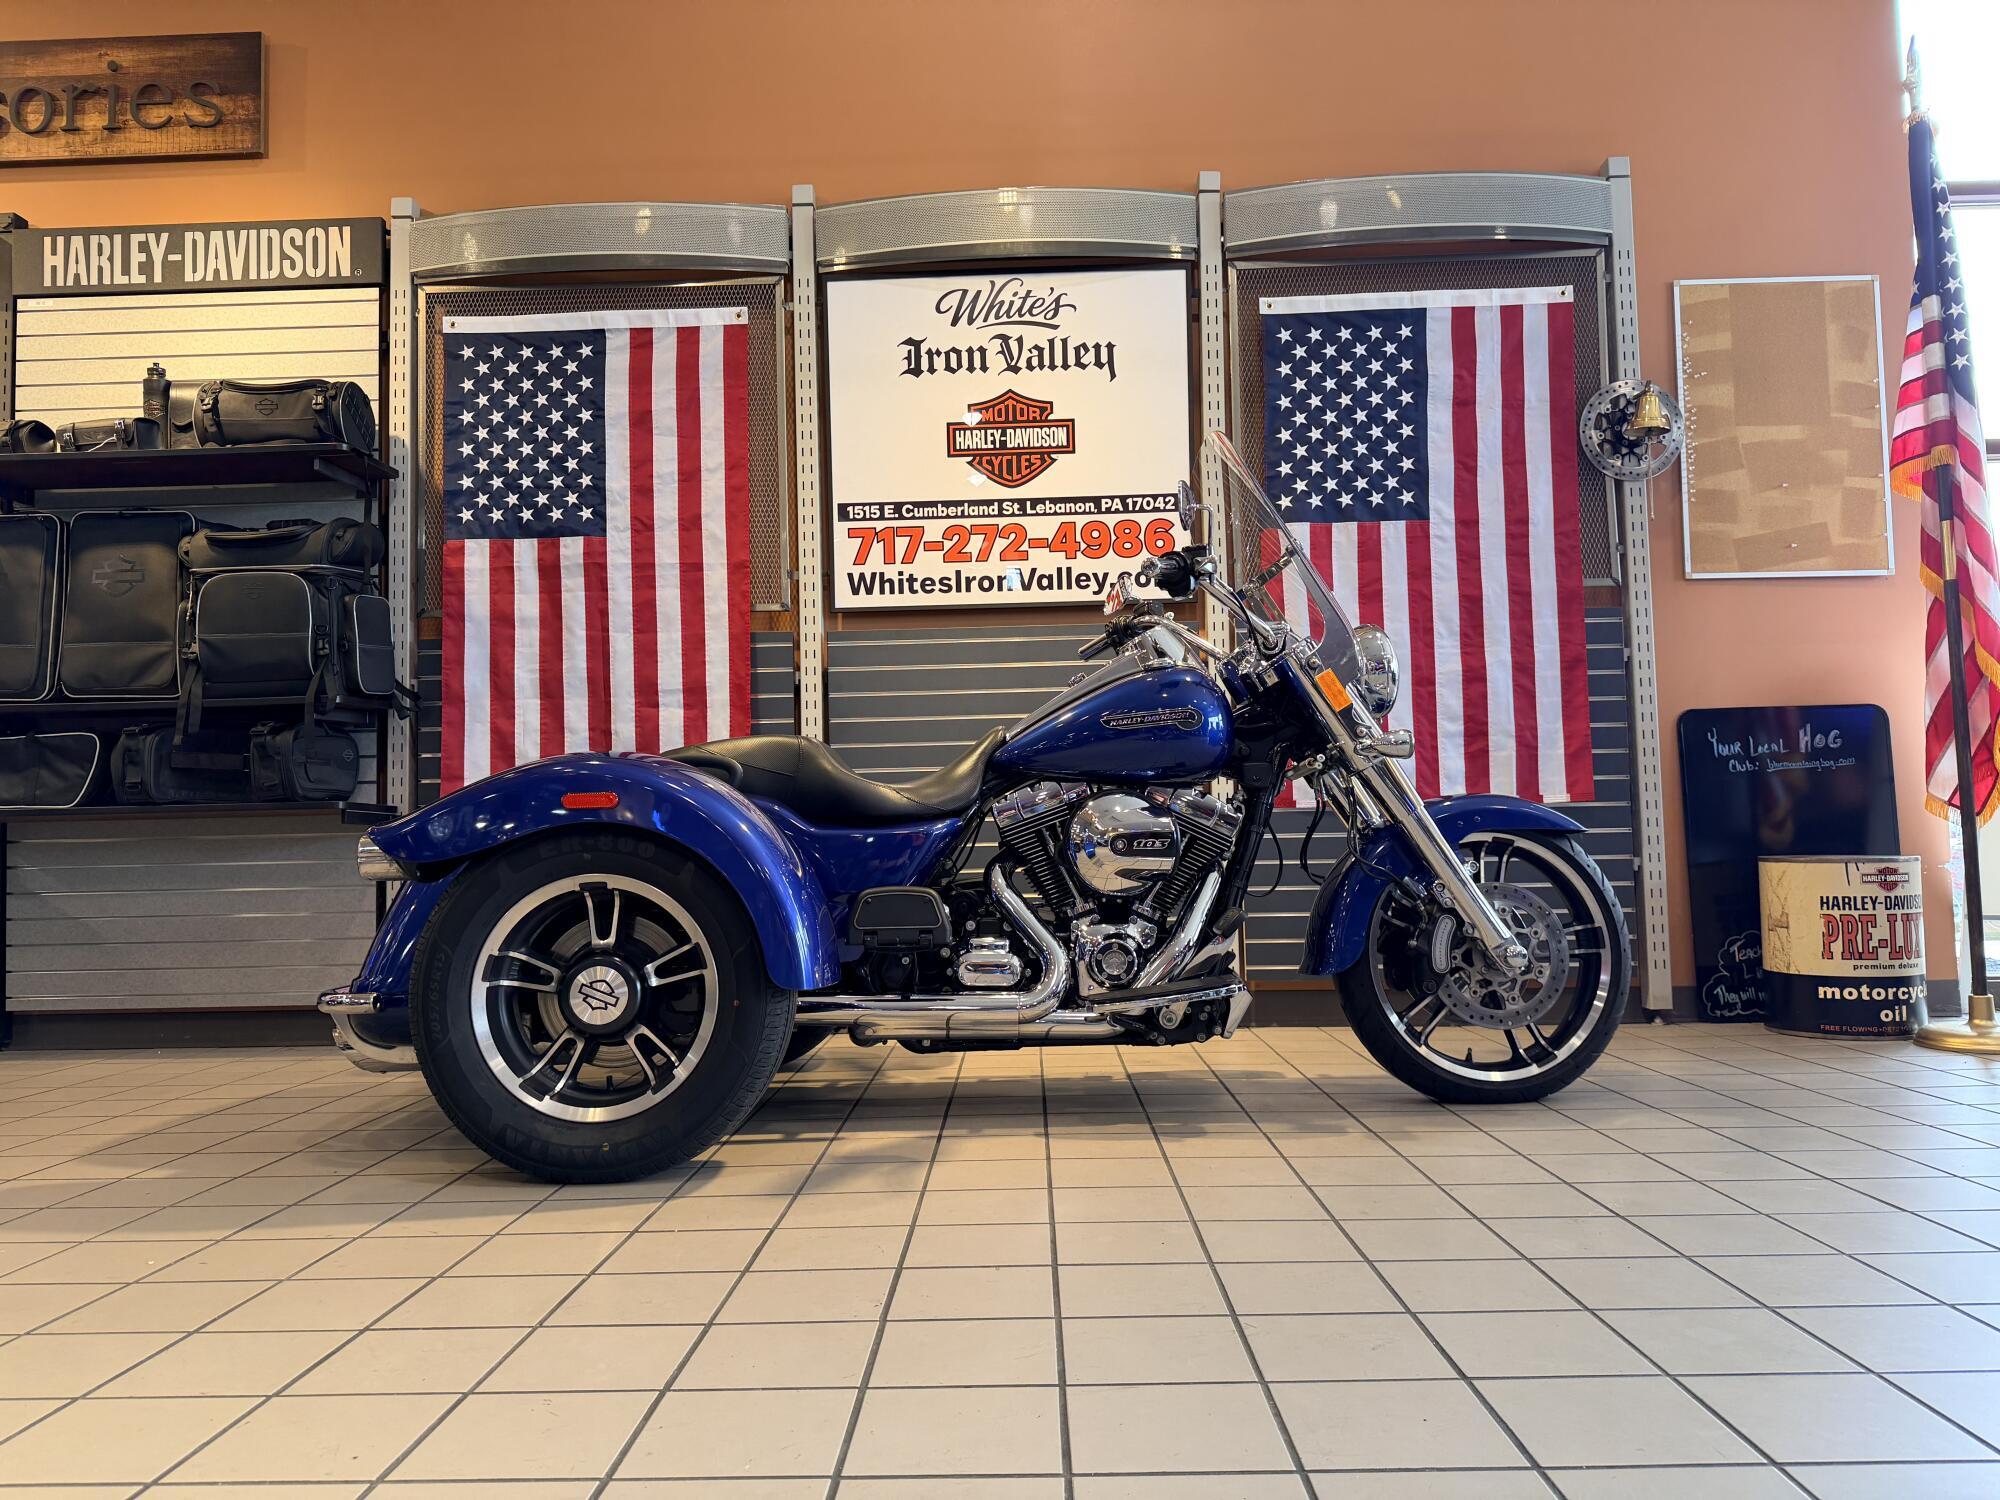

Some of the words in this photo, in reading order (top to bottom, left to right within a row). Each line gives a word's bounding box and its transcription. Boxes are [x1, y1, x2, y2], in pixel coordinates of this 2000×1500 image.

[43, 226, 351, 286] HARLEY-DAVIDSON
[935, 277, 1077, 328] White's
[897, 336, 990, 379] Iron
[988, 333, 1117, 382] Valley
[981, 399, 1041, 422] MOTOR
[955, 426, 1068, 450] HARLEY-DAVIDSON
[982, 454, 1042, 480] CYCLES
[847, 505, 880, 519] 1515
[884, 504, 899, 518] E.
[902, 502, 999, 518] Cumberland
[1002, 501, 1023, 515] St.
[1026, 500, 1098, 515] Lebanon,
[1101, 498, 1124, 512] PA
[1127, 496, 1176, 511] 17042
[848, 518, 1176, 565] 717-272-4986
[1799, 723, 1843, 753] HOG
[1853, 963, 1896, 971] premium
[1817, 981, 1927, 1003] motorcycl
[1880, 1005, 1908, 1022] oil
[1820, 1024, 1840, 1032] FREE
[1842, 1025, 1878, 1033] FLOWING
